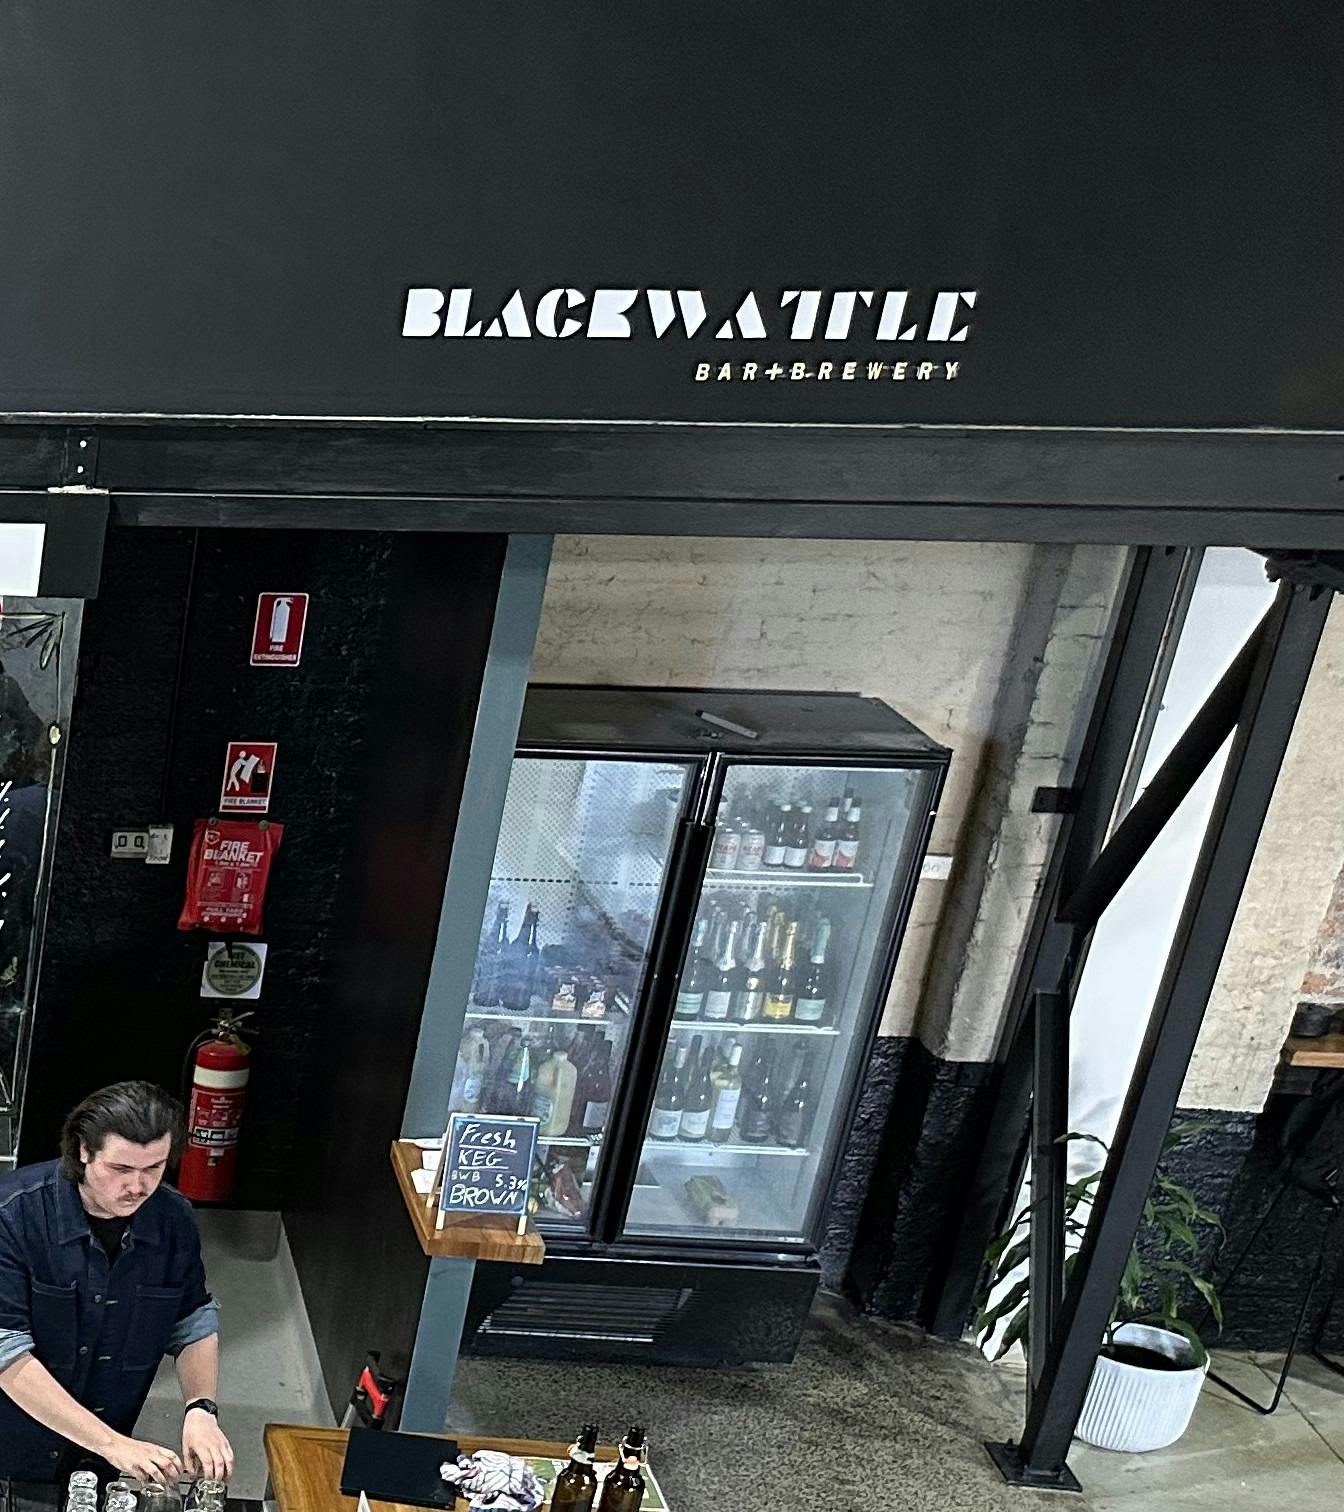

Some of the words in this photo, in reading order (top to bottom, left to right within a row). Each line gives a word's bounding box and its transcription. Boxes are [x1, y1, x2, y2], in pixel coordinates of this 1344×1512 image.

[401, 288, 978, 341] BLACKWATTLE
[220, 841, 251, 852] FIRE
[203, 849, 265, 863] BLANKET
[214, 959, 256, 970] CHEMICAL
[458, 1123, 516, 1149] Fresh
[458, 1150, 503, 1167] KEG
[449, 1184, 519, 1208] BROWN
